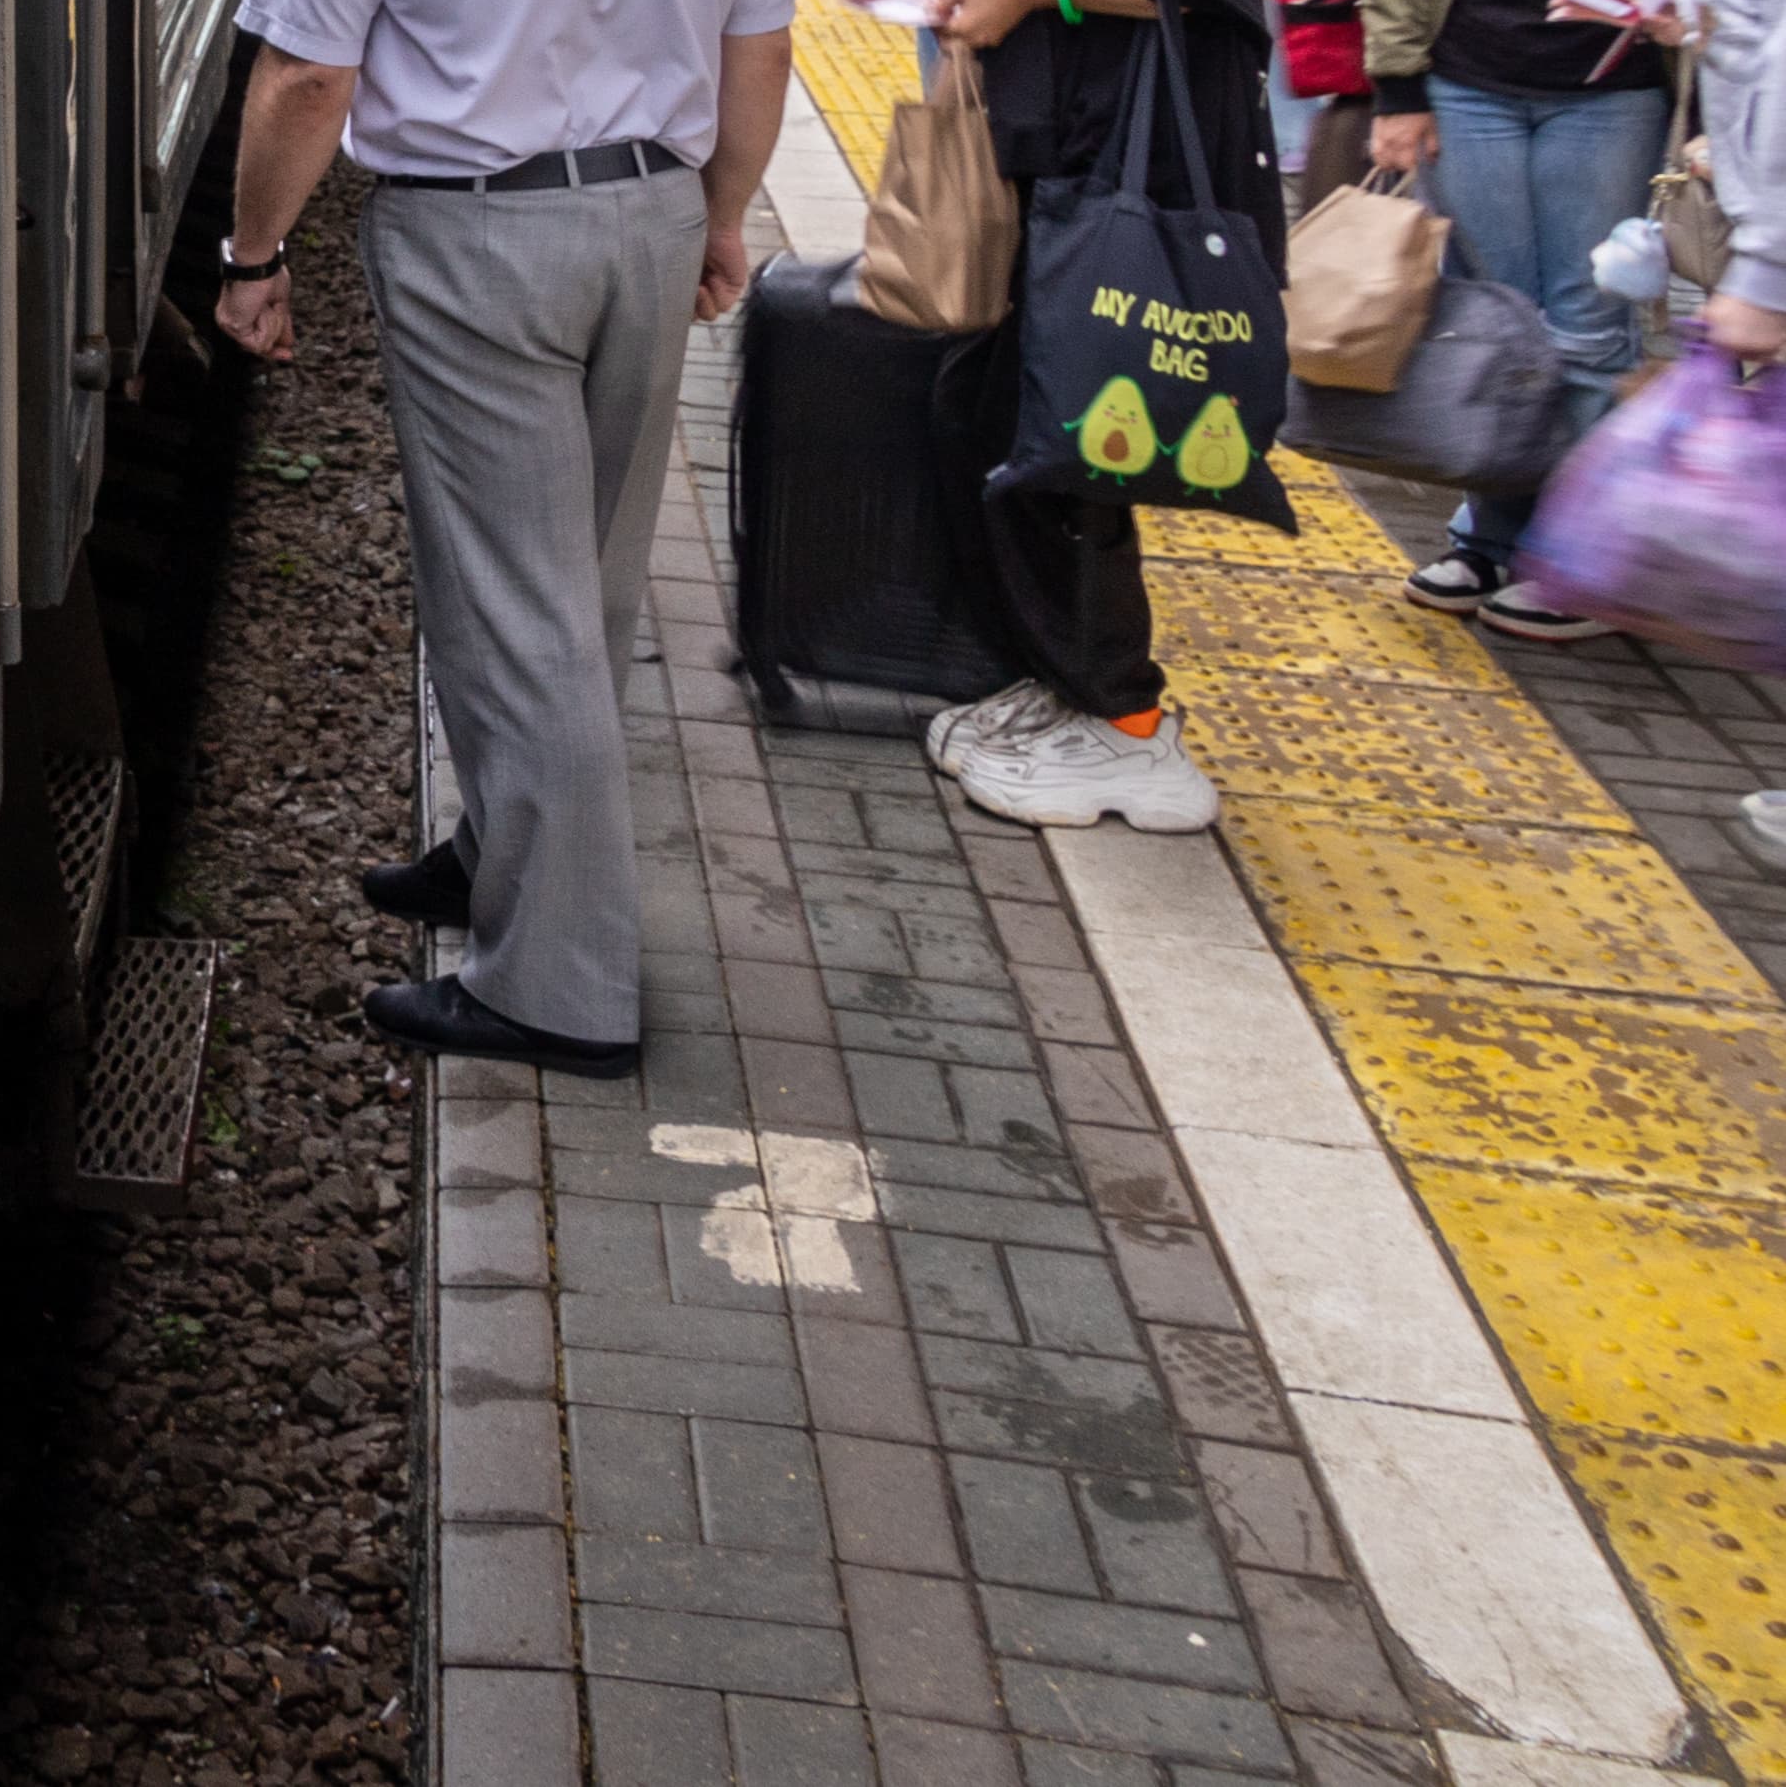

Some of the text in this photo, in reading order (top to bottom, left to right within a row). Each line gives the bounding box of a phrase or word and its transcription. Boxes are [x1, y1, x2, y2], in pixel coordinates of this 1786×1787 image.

[1091, 286, 1252, 344] MY AVOCADO
[1149, 338, 1209, 382] BAG
